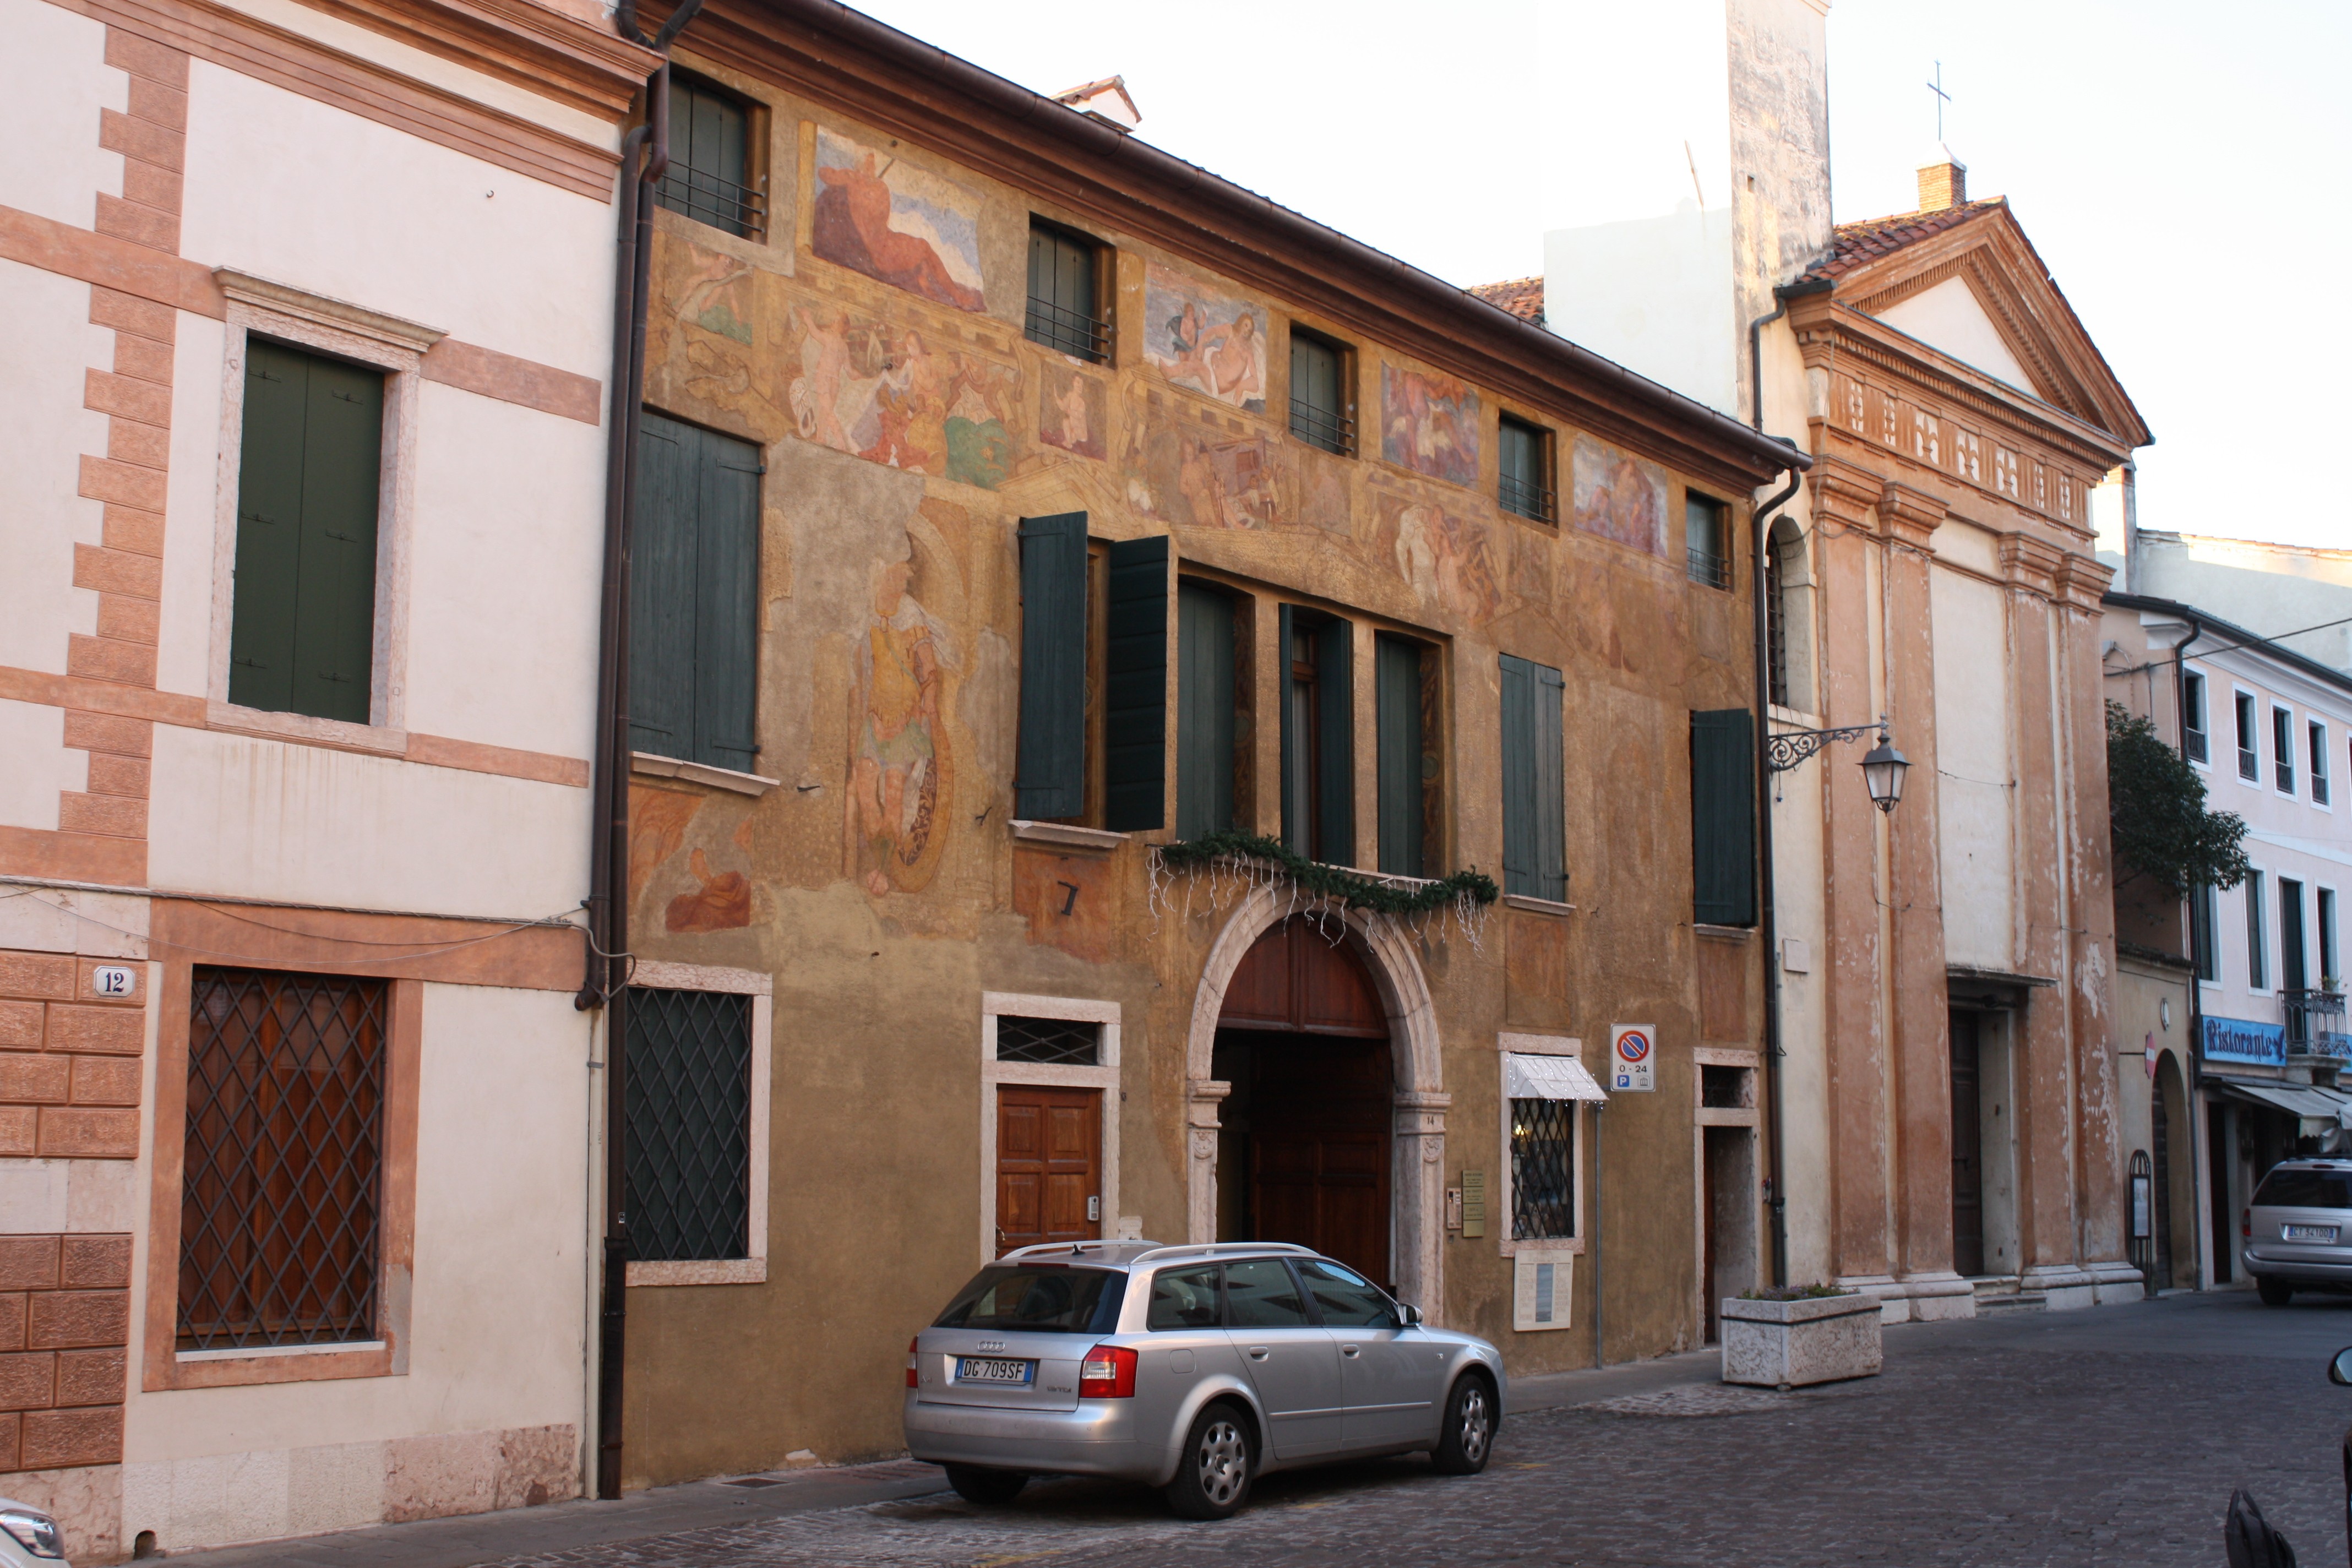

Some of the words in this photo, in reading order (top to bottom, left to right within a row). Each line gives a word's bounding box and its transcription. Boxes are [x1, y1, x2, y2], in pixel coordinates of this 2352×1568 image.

[105, 972, 124, 993] 12
[2207, 1019, 2272, 1063] Ristorante
[1635, 1065, 1647, 1073] 24
[1620, 1077, 1627, 1086] P
[1428, 1115, 1434, 1125] 14
[963, 1360, 979, 1376] DG
[983, 1361, 1024, 1379] 709SF
